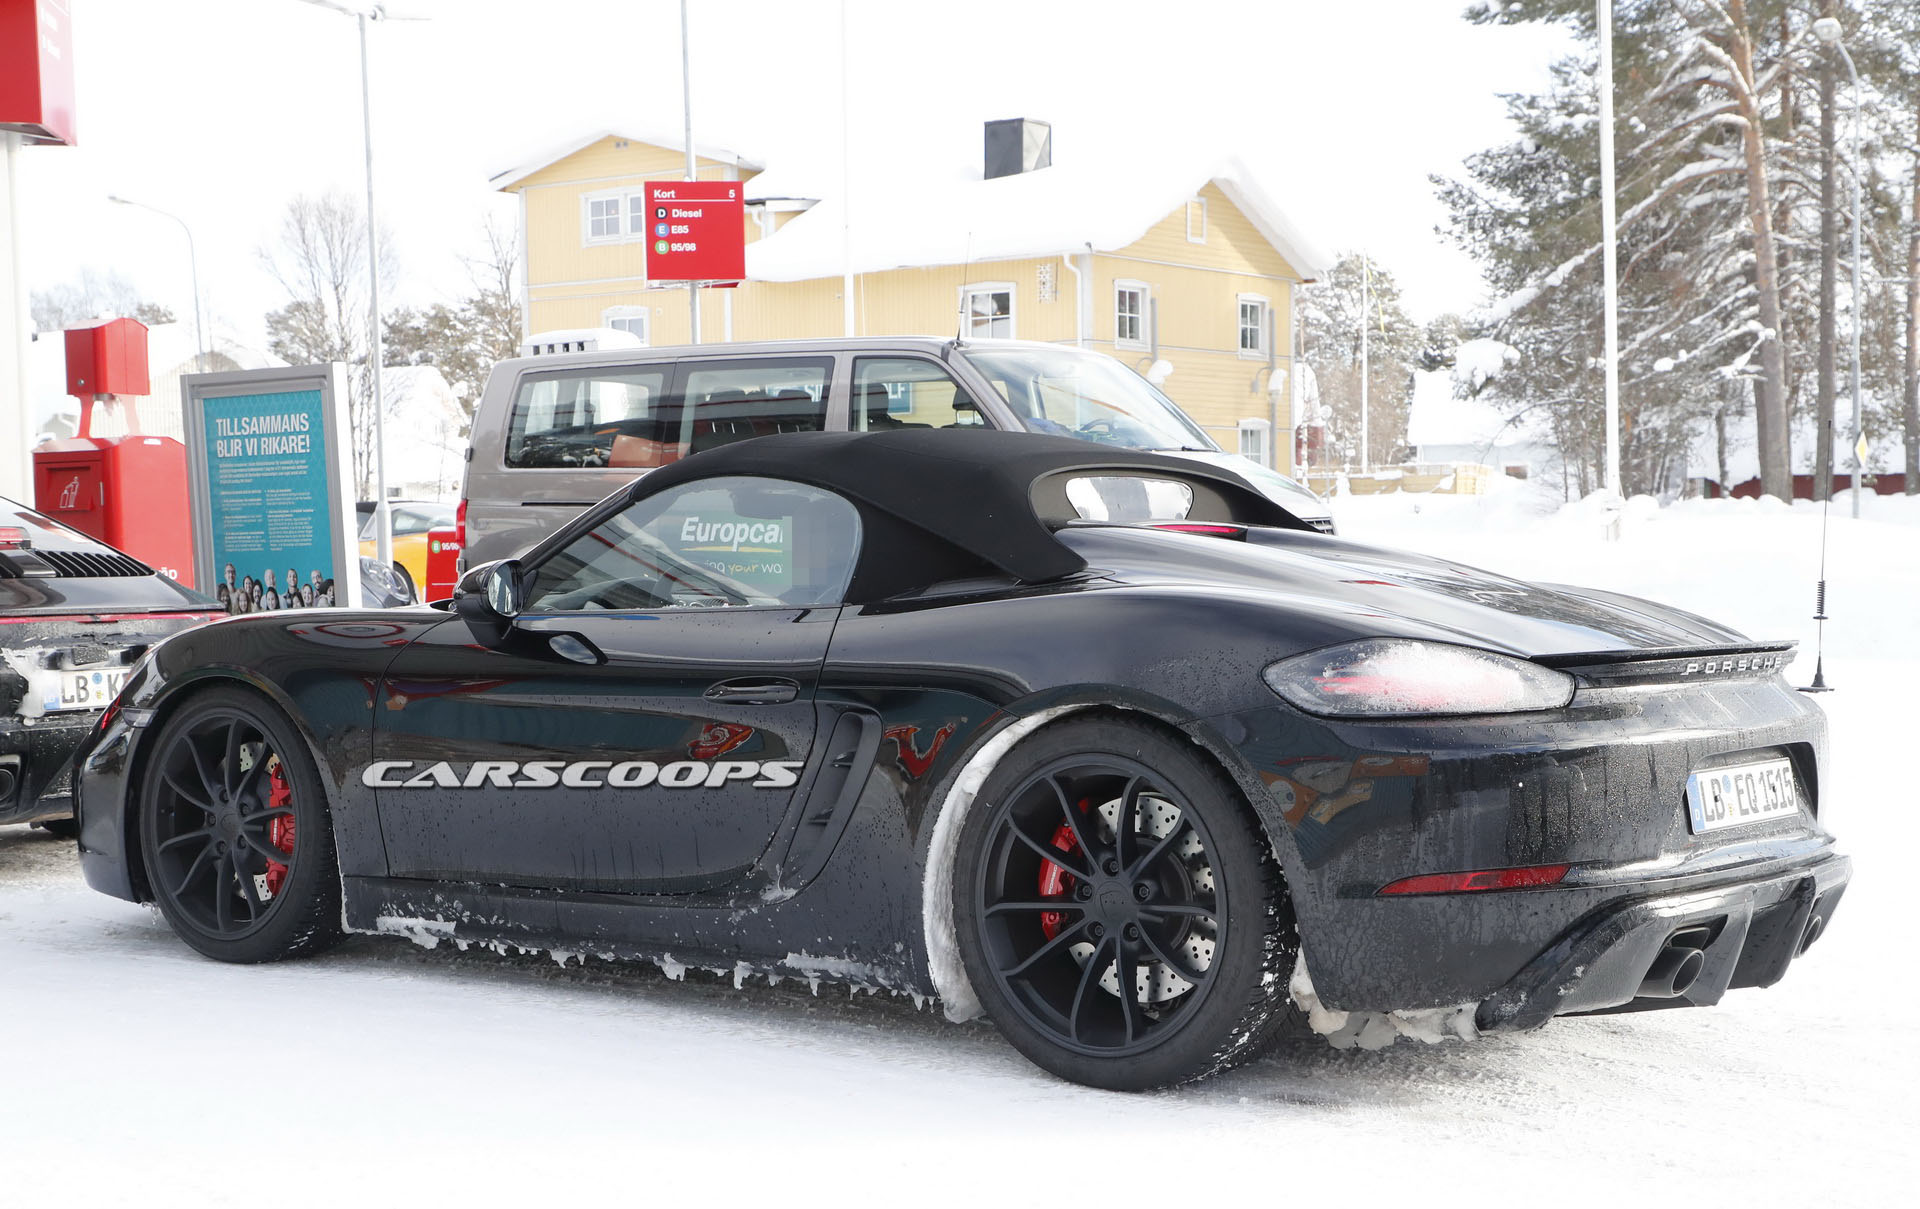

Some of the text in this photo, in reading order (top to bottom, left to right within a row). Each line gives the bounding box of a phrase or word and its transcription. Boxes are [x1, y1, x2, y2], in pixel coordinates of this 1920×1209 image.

[653, 189, 736, 199] Kort 5
[671, 208, 702, 218] Diesel
[671, 225, 689, 234] E85
[671, 242, 697, 252] 95/98
[216, 412, 310, 436] TILLSAMMANS
[216, 434, 311, 458] BLIR VI RIKARE!
[727, 563, 760, 576] your
[761, 563, 784, 574] wa
[1684, 657, 1782, 675] PORSCHE
[1700, 778, 1726, 822] LB
[1760, 766, 1795, 812] 1515
